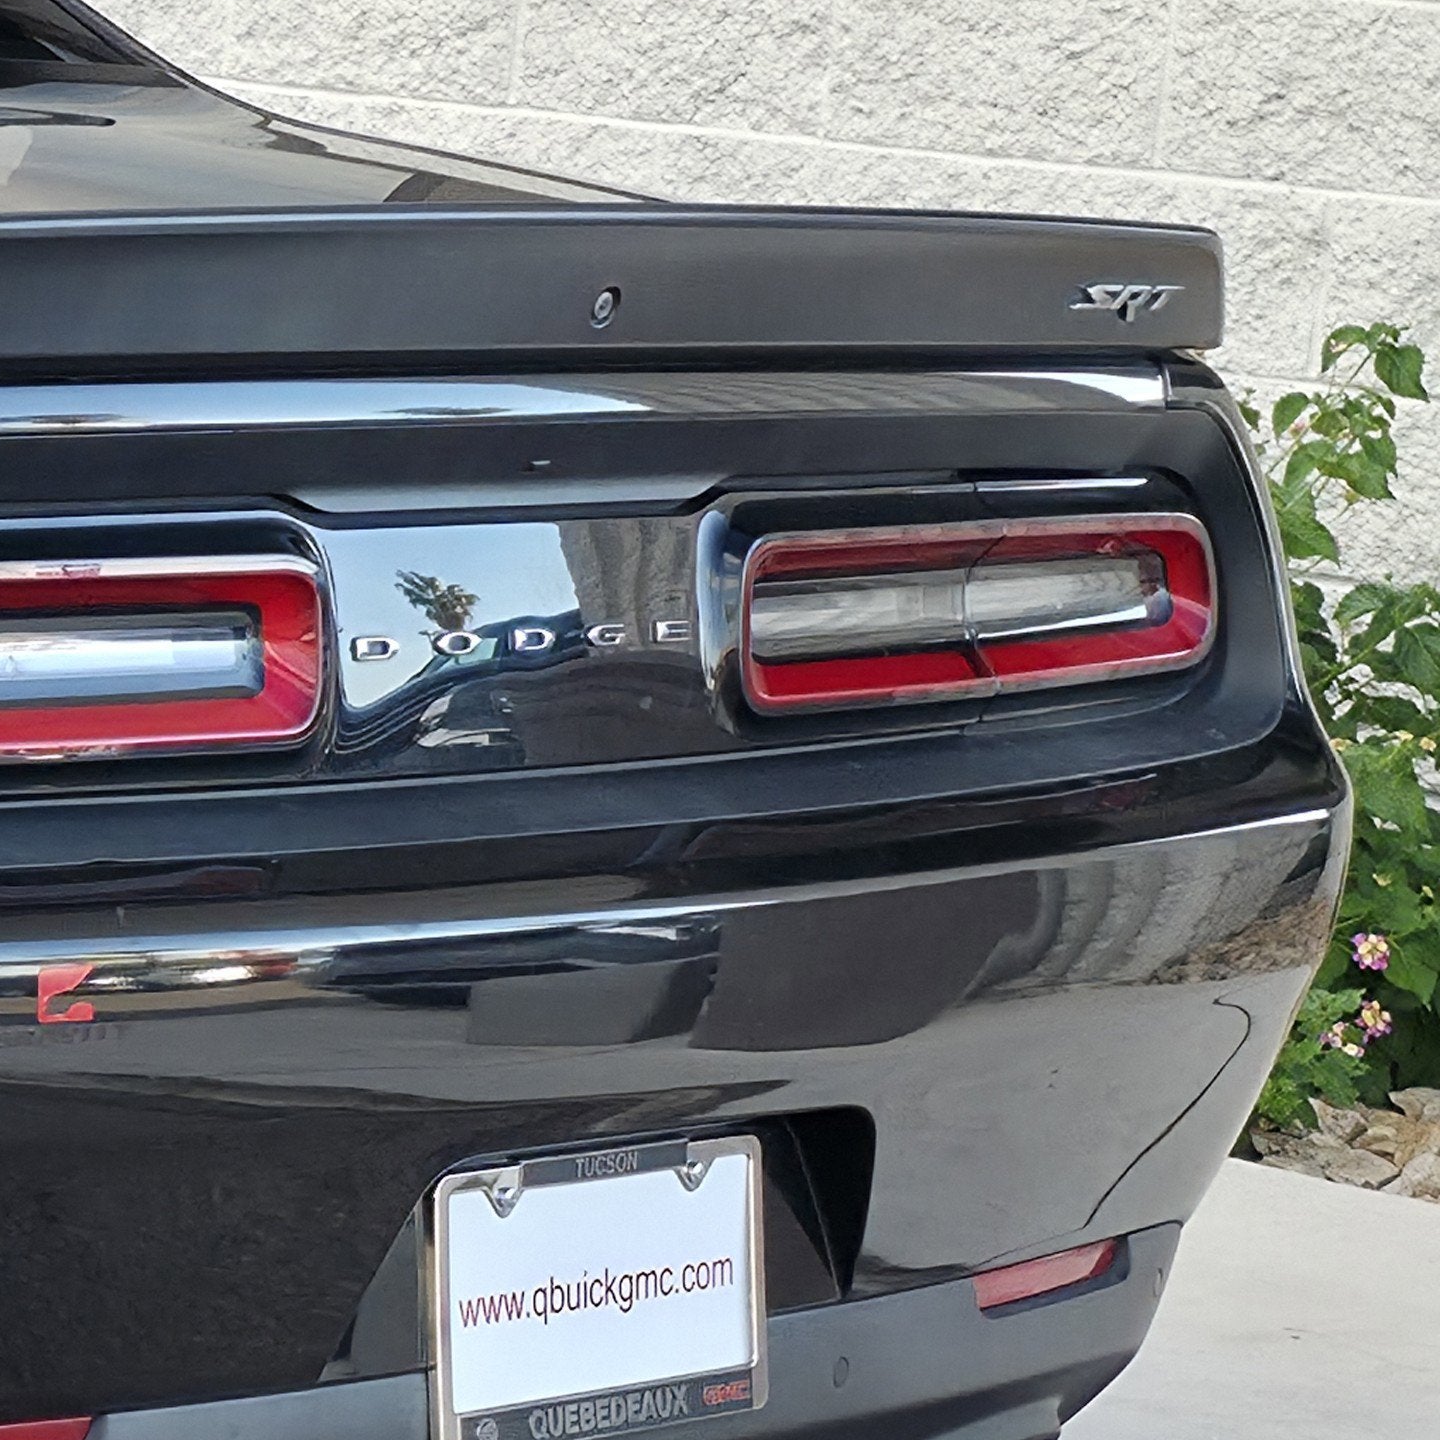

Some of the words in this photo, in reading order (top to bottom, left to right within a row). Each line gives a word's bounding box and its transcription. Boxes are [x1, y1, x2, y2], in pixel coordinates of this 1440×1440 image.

[1069, 284, 1186, 322] SRT
[351, 620, 690, 661] DODGE
[575, 1151, 638, 1178] TUCSON
[459, 1257, 734, 1328] www.qbuickgmc.com
[529, 1382, 690, 1440] QUEBEDEAUX
